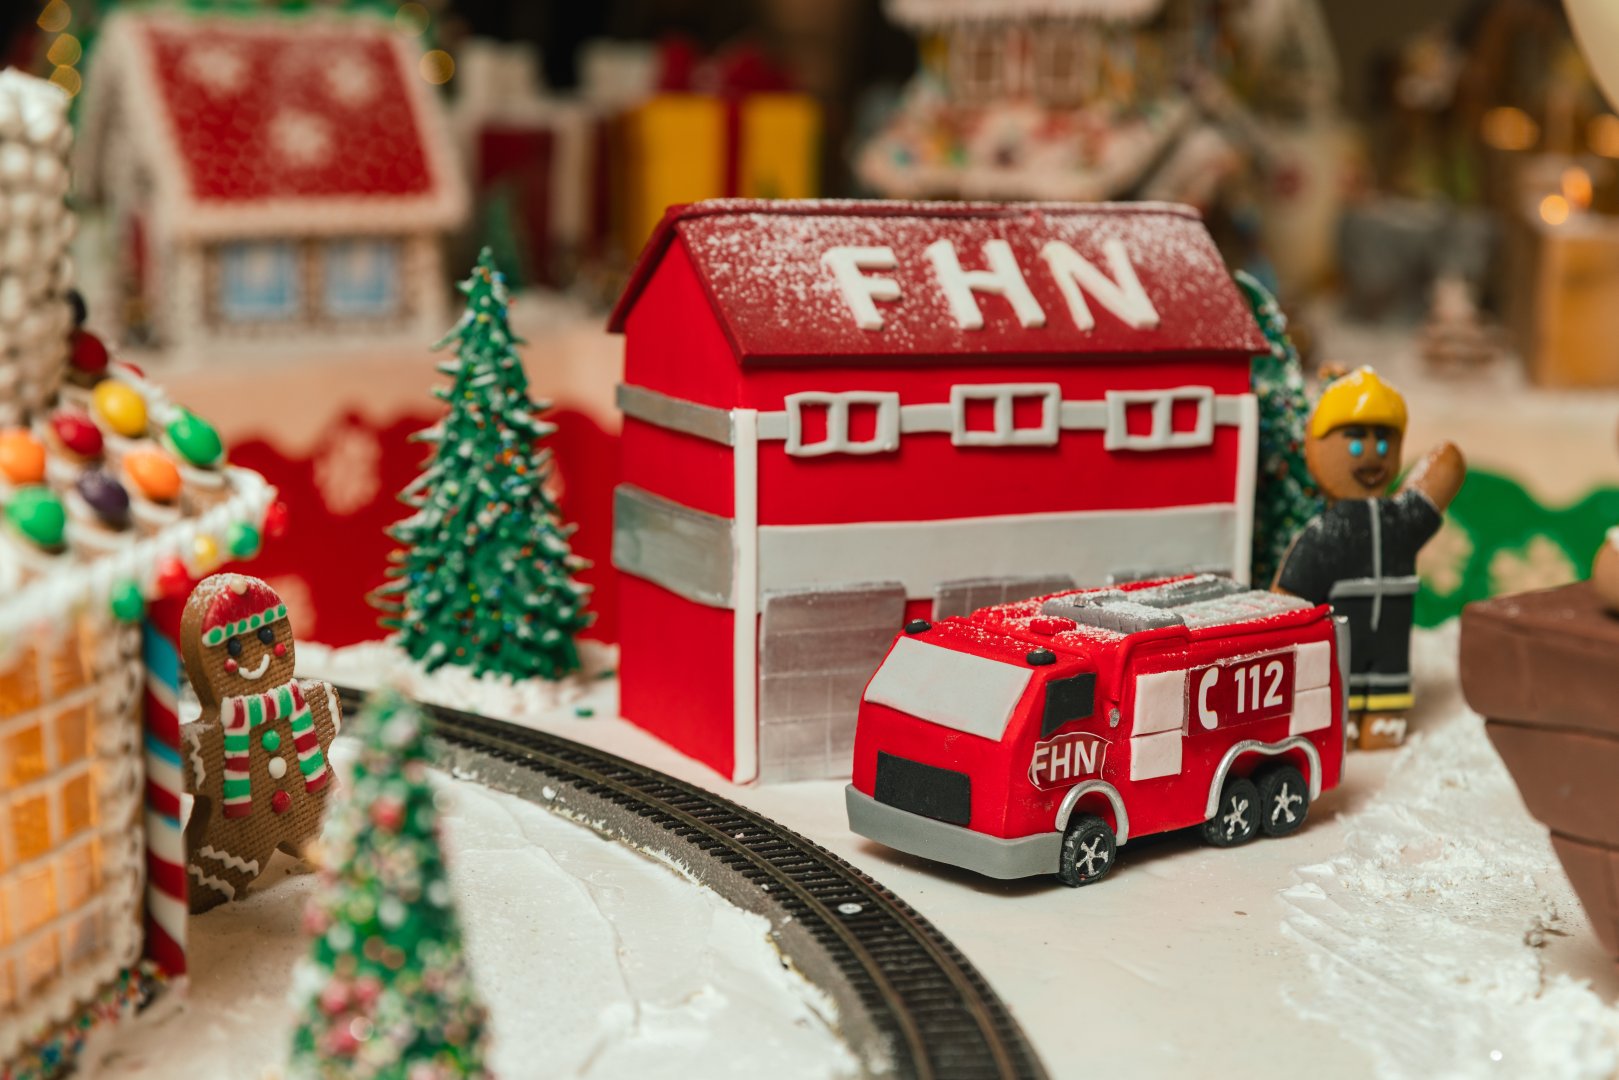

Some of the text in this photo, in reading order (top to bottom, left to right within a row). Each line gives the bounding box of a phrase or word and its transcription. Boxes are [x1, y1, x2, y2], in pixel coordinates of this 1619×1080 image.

[821, 239, 1160, 331] FHN
[1234, 661, 1284, 714] 112
[1032, 740, 1100, 785] FHN
